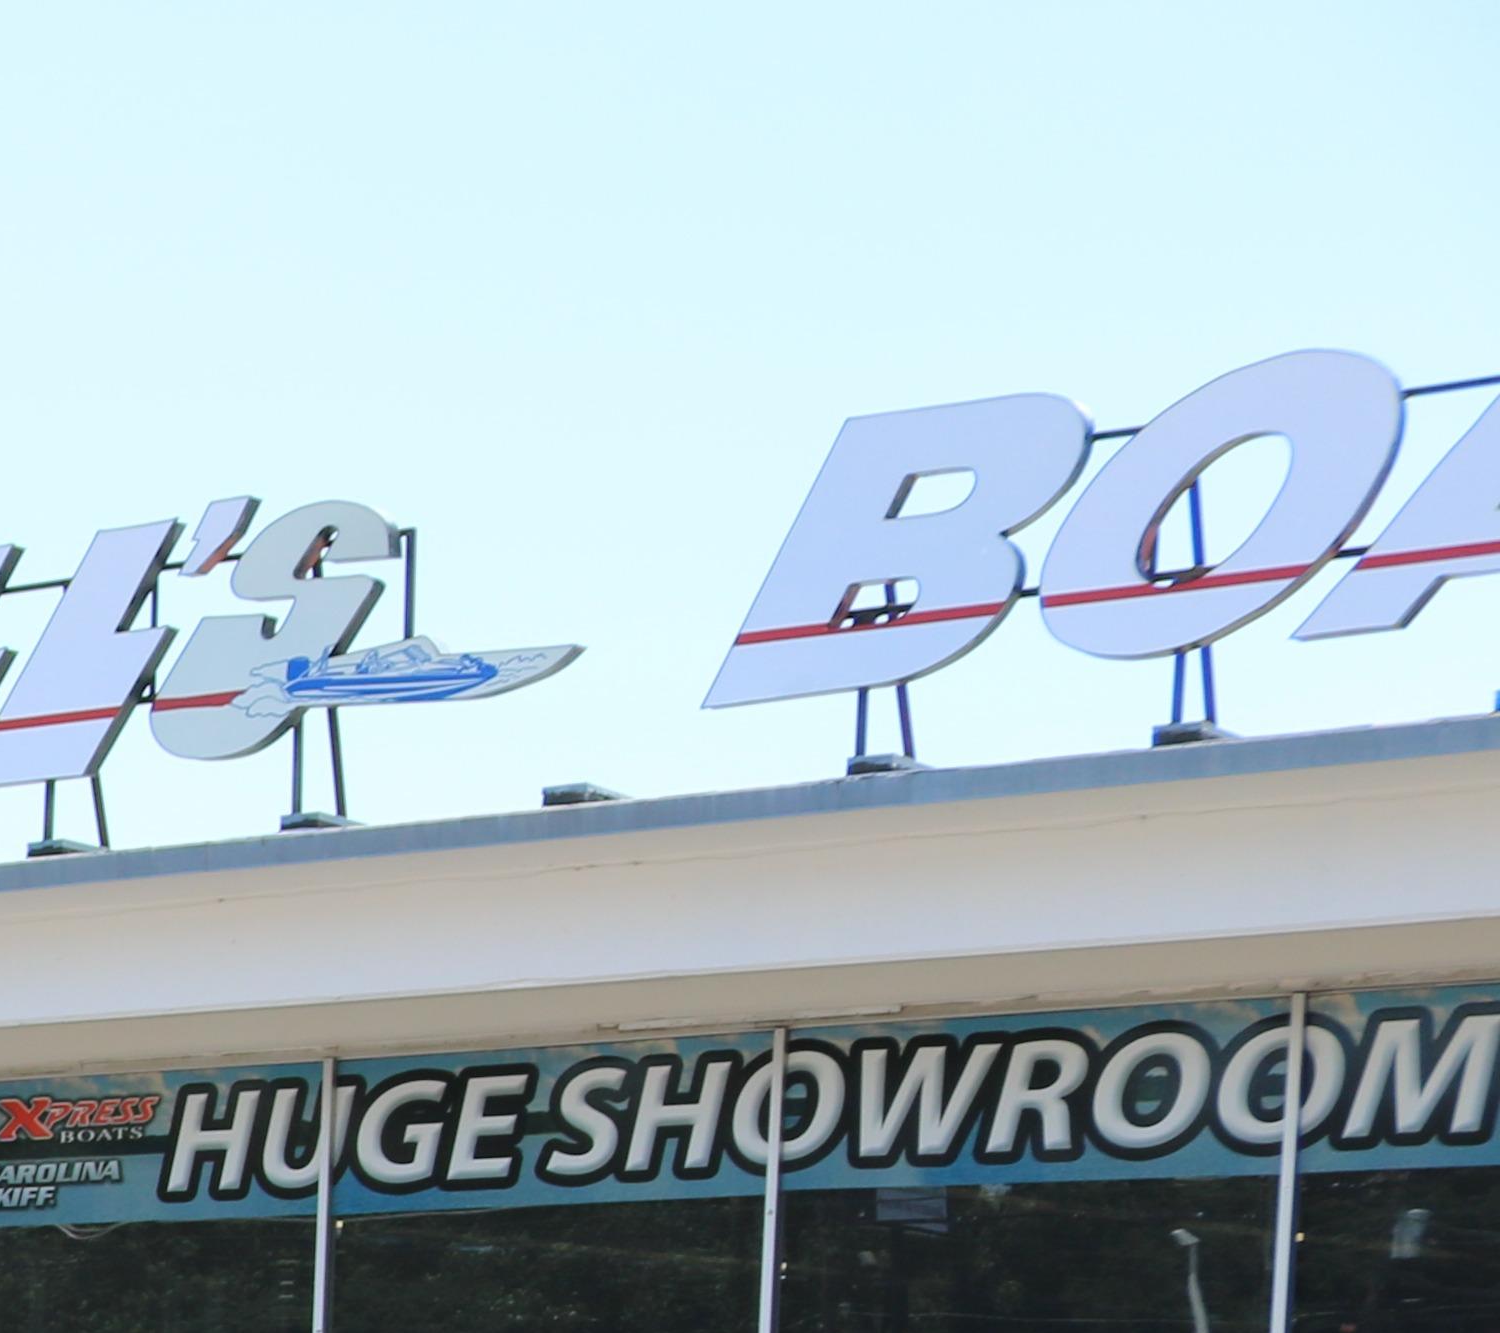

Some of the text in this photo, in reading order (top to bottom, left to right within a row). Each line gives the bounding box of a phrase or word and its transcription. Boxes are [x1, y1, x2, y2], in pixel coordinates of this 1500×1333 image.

[59, 1126, 144, 1144] BOATS
[162, 1012, 1500, 1196] HUGE SHOWROOM
